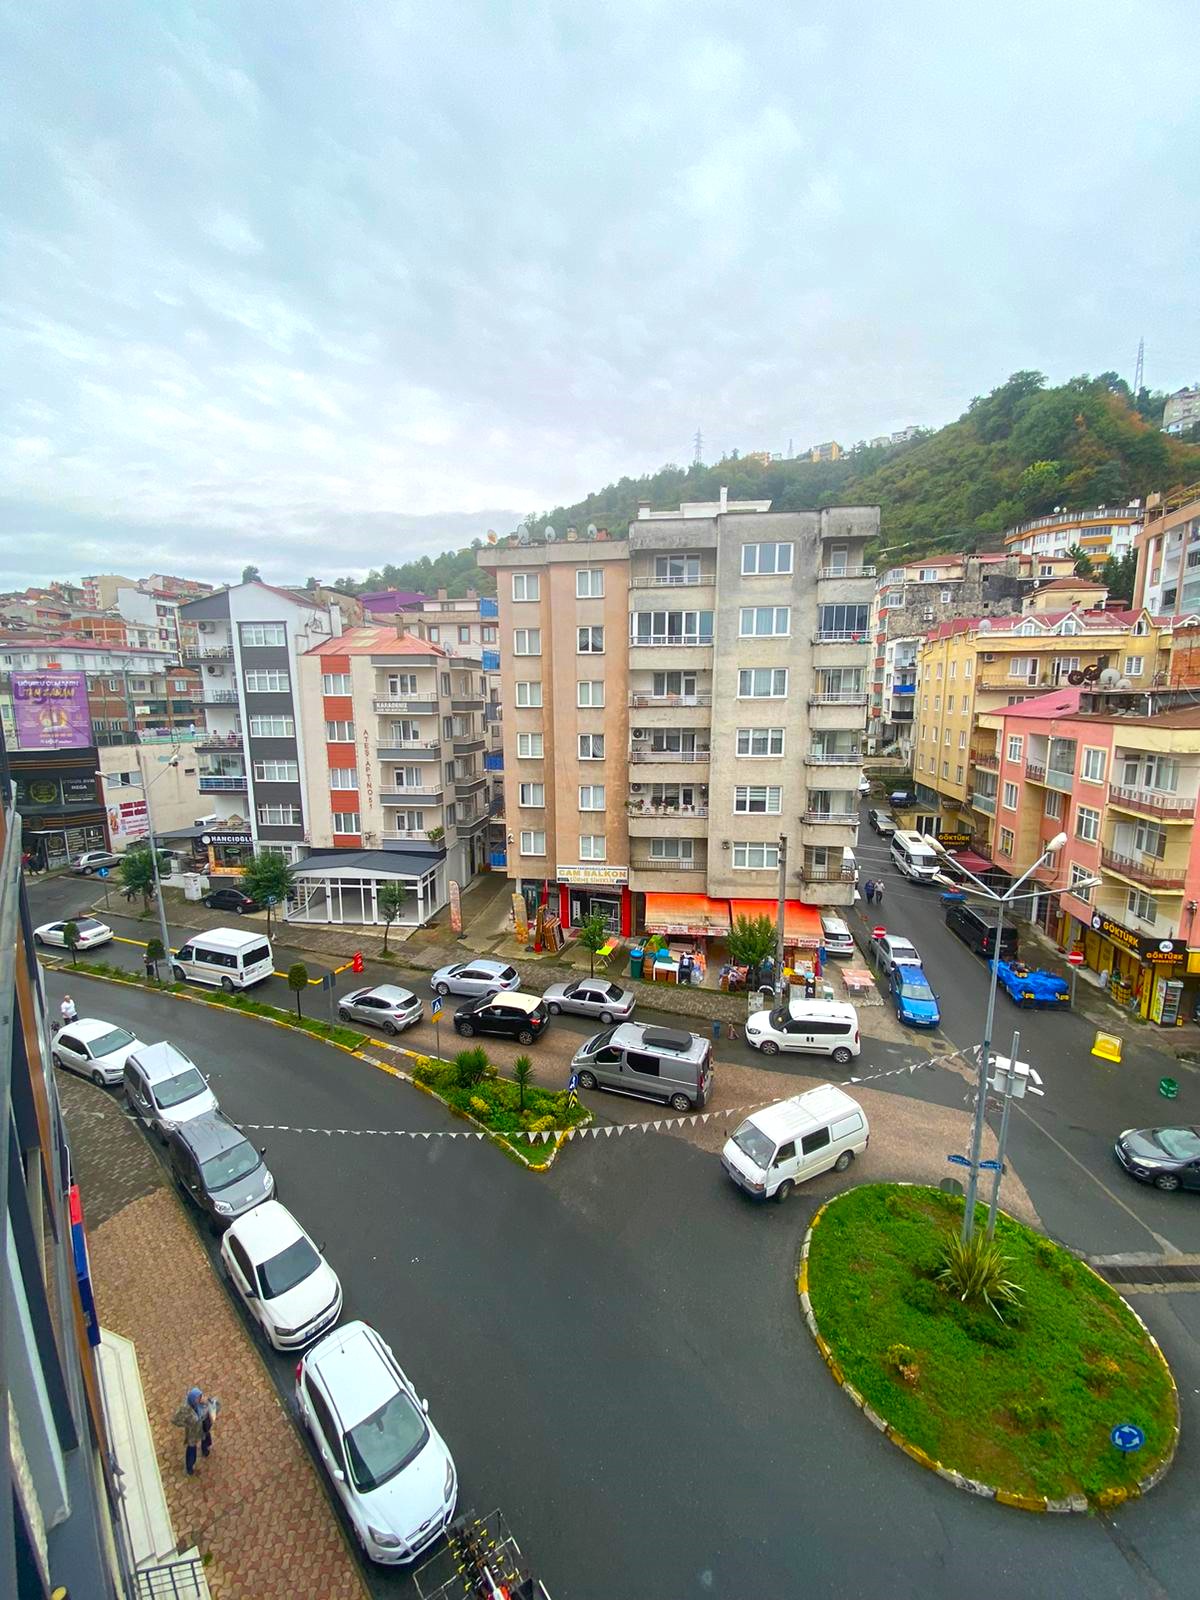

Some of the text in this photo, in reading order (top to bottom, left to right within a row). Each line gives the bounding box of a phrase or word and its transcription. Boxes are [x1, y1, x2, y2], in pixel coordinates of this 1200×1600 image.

[584, 870, 626, 878] BALKON
[1103, 921, 1139, 947] GÖKTÜRK
[1146, 951, 1184, 960] GÖKTÜRK
